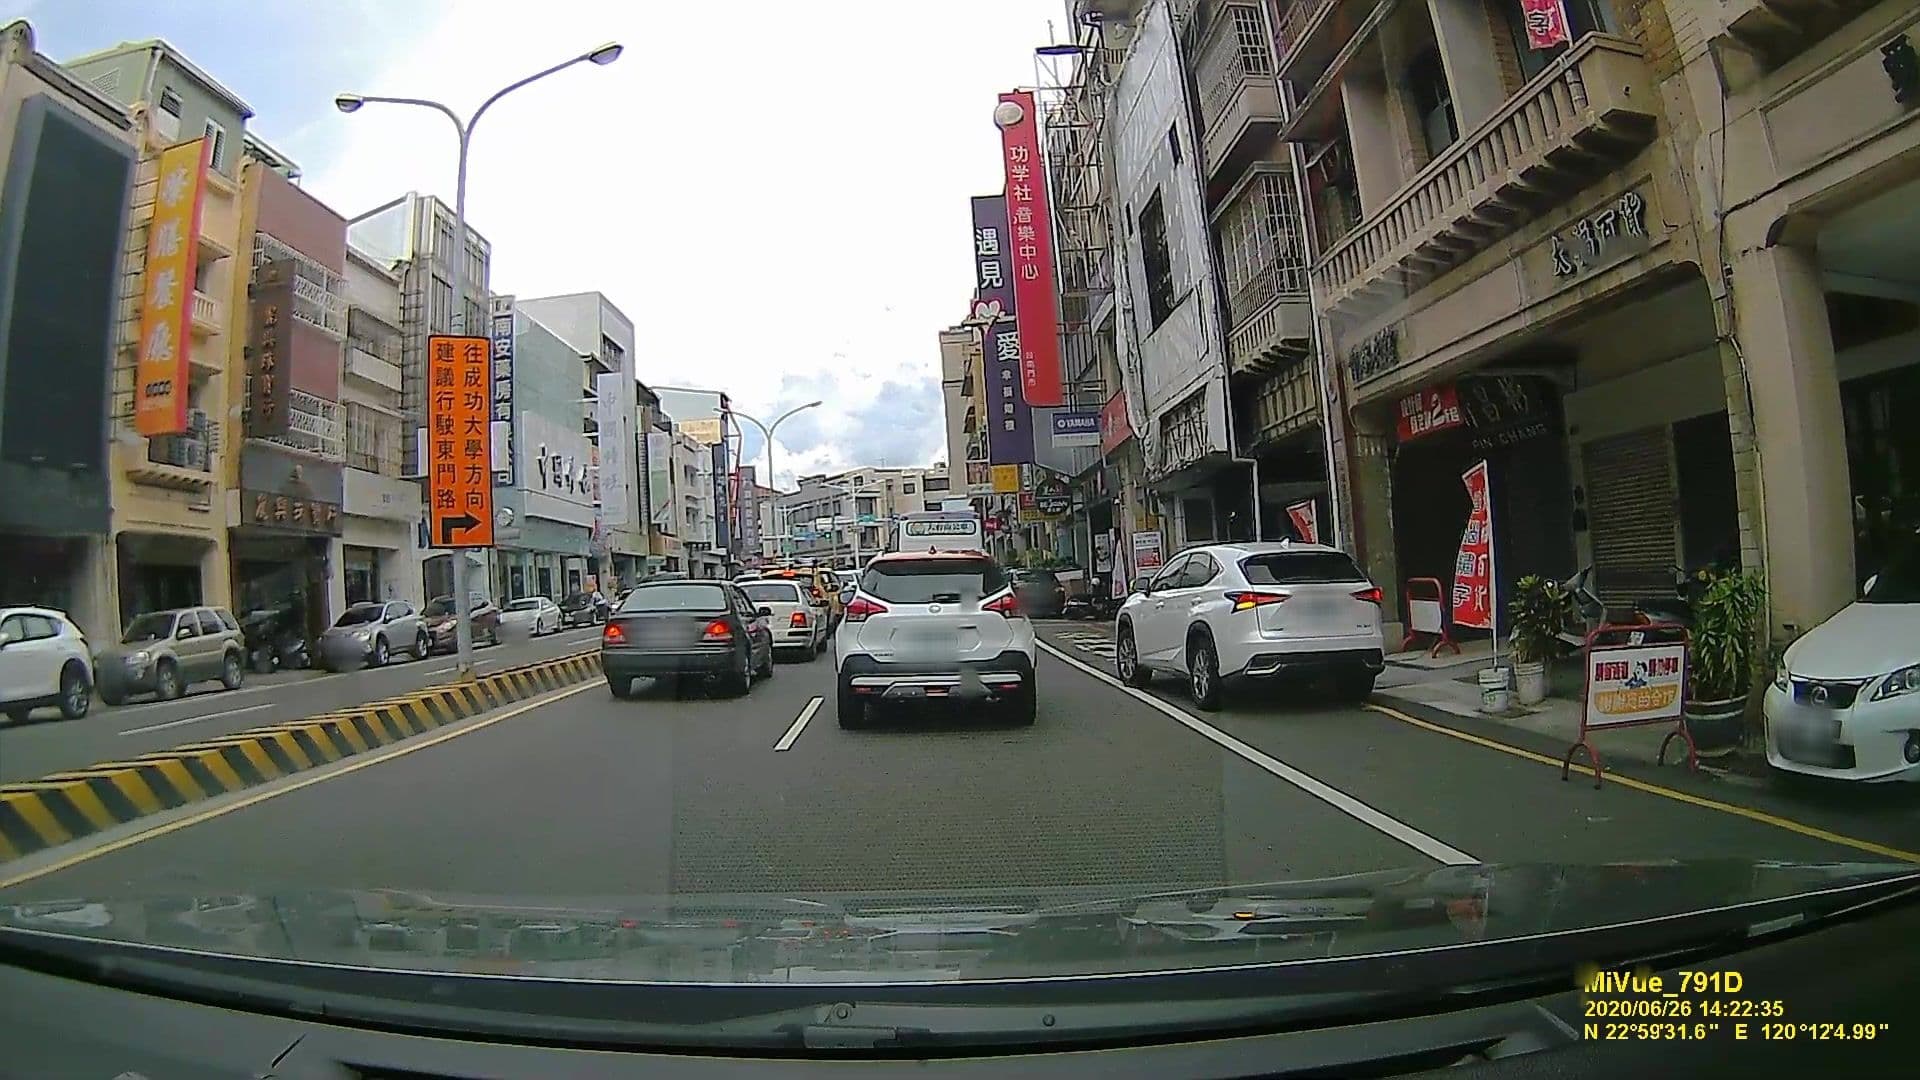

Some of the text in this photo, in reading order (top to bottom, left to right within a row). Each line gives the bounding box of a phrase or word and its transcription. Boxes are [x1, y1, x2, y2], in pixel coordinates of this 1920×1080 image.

[436, 343, 456, 510] 建議行駛東門路
[463, 343, 485, 511] 往成功大學方向
[1066, 417, 1096, 428] YAMAHA
